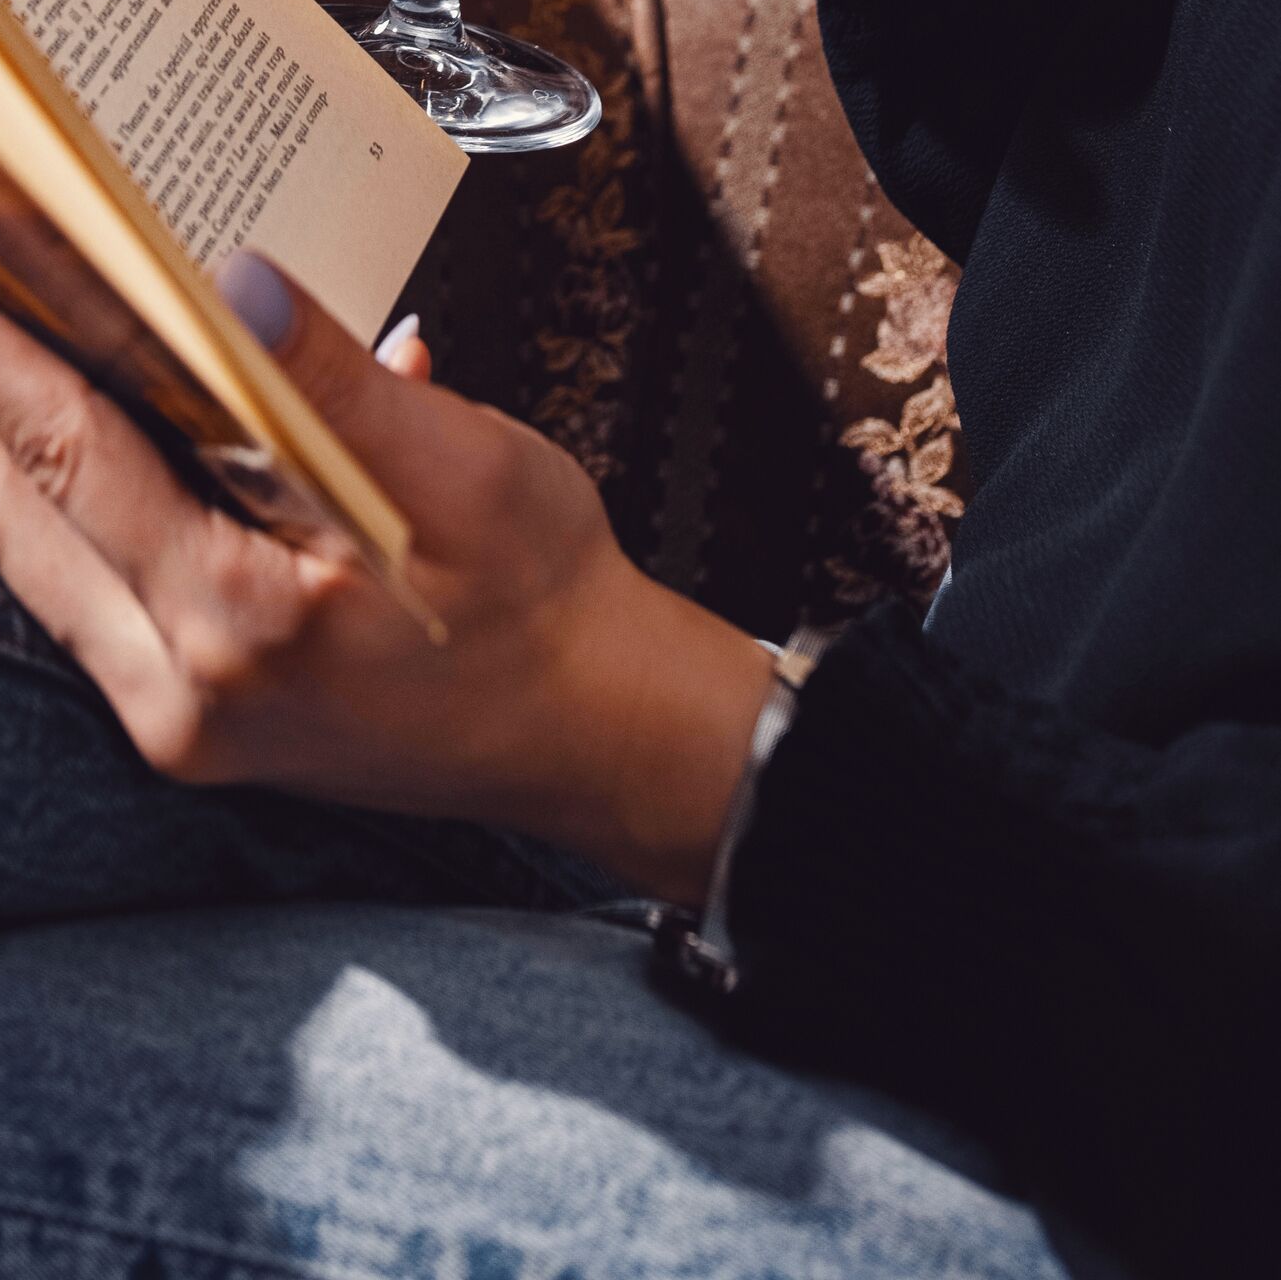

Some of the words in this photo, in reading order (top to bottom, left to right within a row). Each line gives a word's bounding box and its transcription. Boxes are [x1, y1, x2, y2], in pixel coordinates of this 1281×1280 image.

[82, 24, 100, 44] de
[108, 5, 164, 84] appartenaient
[112, 13, 133, 35] les
[145, 82, 163, 103] de
[154, 31, 195, 87] l'apéritif
[161, 68, 201, 120] accident,
[194, 30, 223, 71] qu'une
[215, 1, 241, 38] jeune
[186, 99, 203, 120] un
[196, 72, 221, 104] train
[211, 45, 238, 78] (sans
[230, 16, 256, 50] doute
[188, 119, 219, 158] matin,
[213, 85, 236, 119] celui
[231, 65, 248, 91] qui
[243, 30, 272, 75] passait
[222, 122, 238, 143] ne
[232, 88, 261, 127] savait
[253, 68, 272, 96] pas
[264, 45, 287, 73] trop
[230, 142, 249, 164] Le
[243, 101, 273, 152] second
[266, 91, 282, 111] en
[275, 59, 301, 101] moins
[268, 109, 294, 142] Mais
[284, 97, 300, 116] il
[292, 73, 316, 107] allait
[259, 166, 284, 196] bien
[278, 142, 299, 171] cela
[293, 119, 311, 146] qui
[305, 90, 330, 126] comp-
[368, 140, 385, 163] 53
